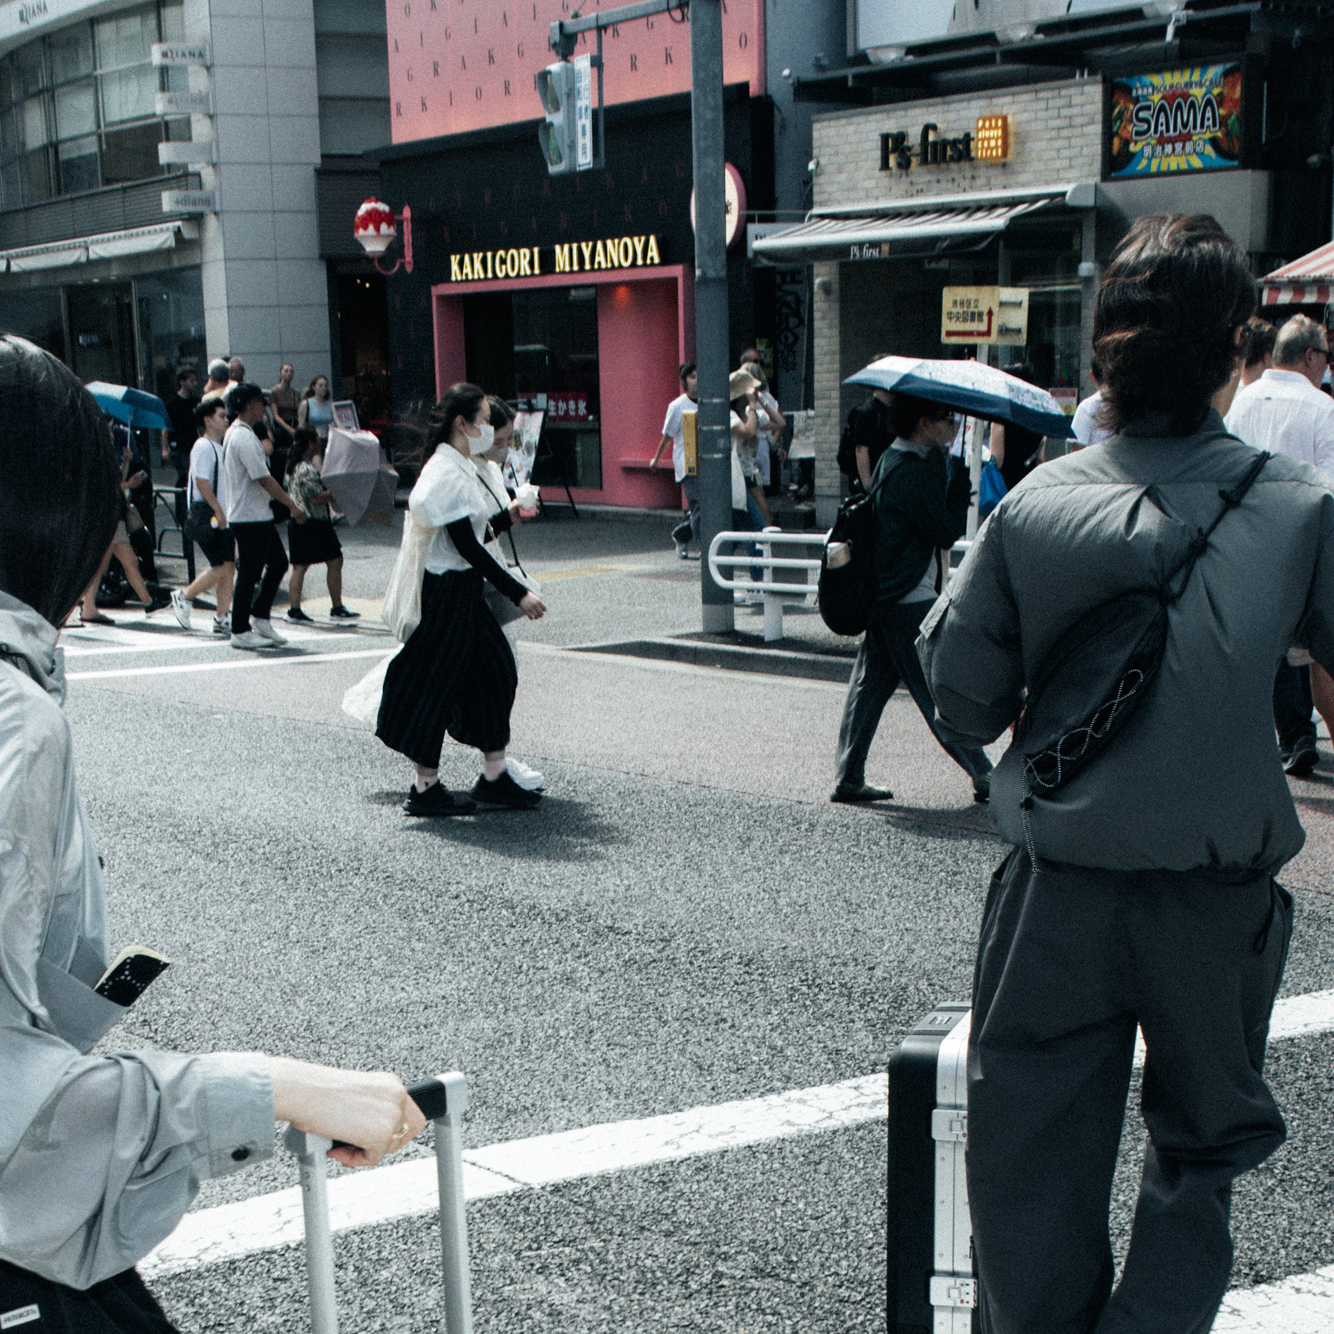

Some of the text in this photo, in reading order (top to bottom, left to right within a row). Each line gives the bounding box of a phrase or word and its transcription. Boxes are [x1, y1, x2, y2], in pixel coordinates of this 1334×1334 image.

[1131, 93, 1220, 141] SAMA
[450, 233, 661, 282] KAKIGORI MIYANOYA
[547, 398, 588, 417] 生かき氷
